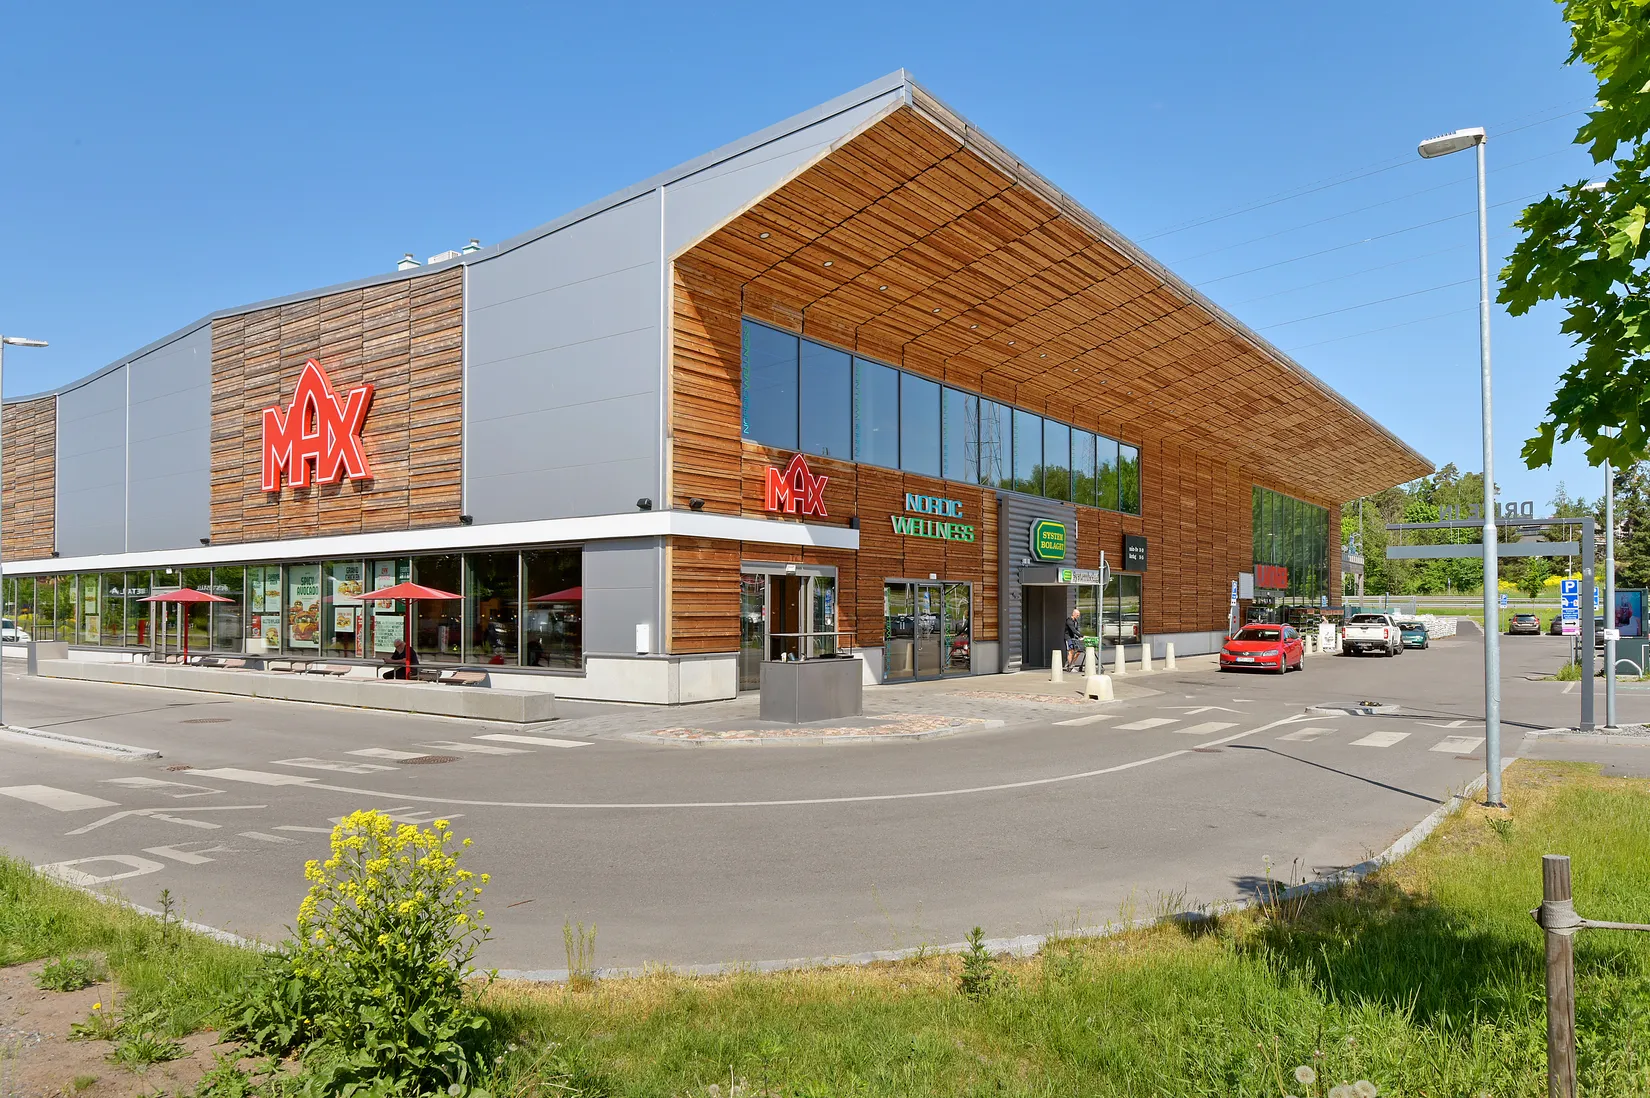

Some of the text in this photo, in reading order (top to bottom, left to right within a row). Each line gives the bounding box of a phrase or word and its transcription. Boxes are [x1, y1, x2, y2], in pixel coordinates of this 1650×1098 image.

[261, 358, 374, 492] MAX
[765, 452, 829, 517] MAX
[905, 492, 963, 518] NORDIC
[890, 515, 975, 542] WELLNESS
[1042, 531, 1063, 541] SYSTEM
[301, 576, 314, 585] SPICY
[1565, 581, 1575, 593] P
[297, 586, 318, 595] AVOCADO
